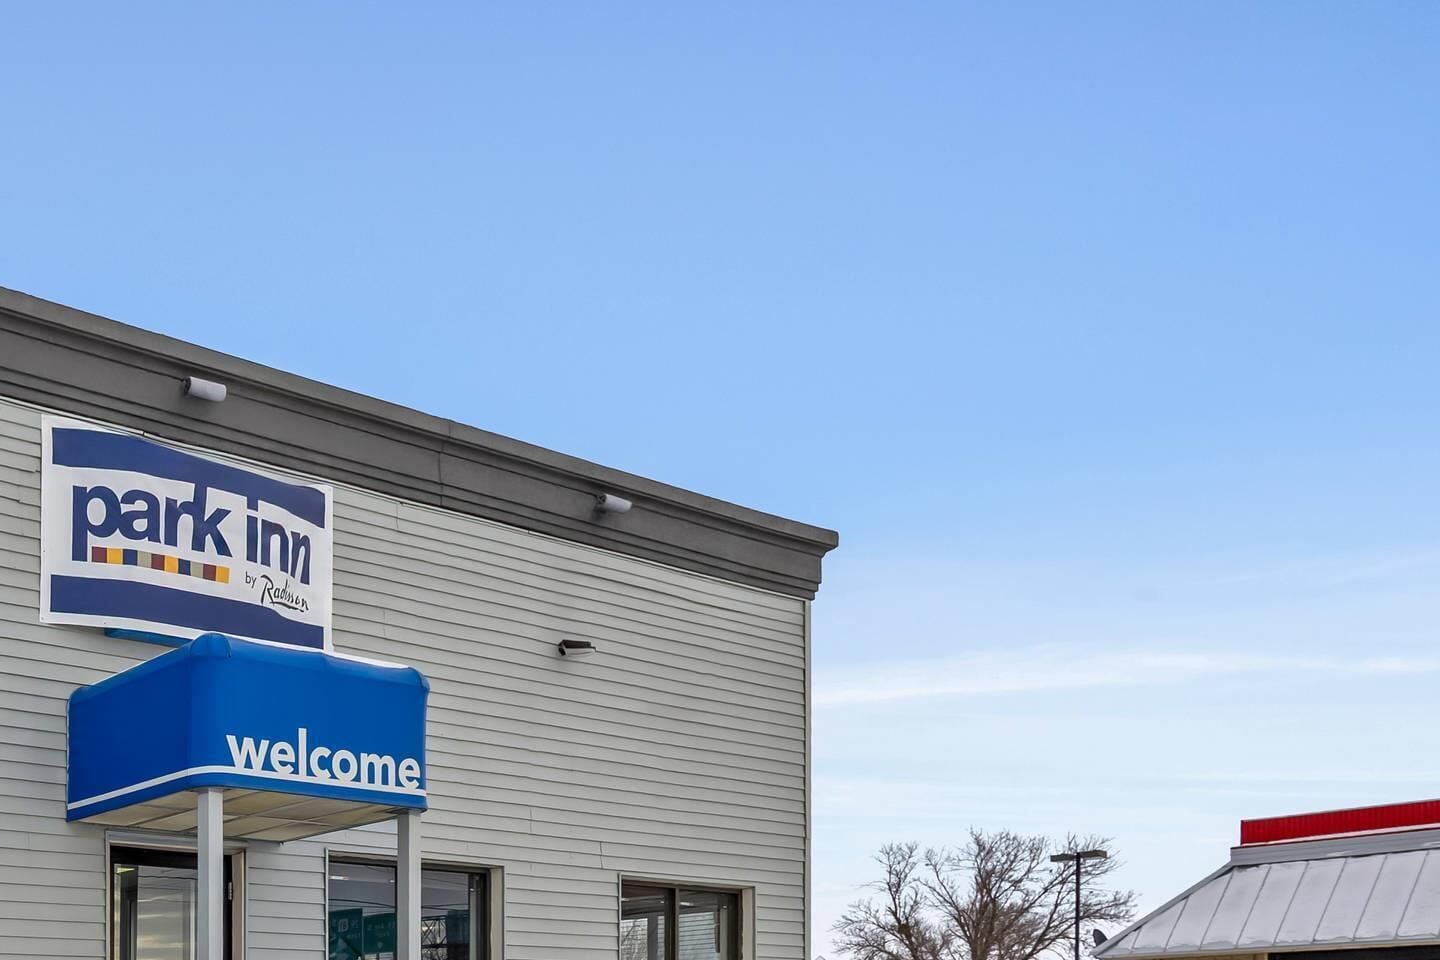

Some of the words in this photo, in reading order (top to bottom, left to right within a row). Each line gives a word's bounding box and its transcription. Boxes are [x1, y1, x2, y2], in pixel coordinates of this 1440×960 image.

[72, 483, 232, 562] park
[246, 497, 310, 585] inn
[245, 570, 257, 589] by
[260, 574, 309, 612] Radisson
[226, 728, 421, 790] welcome
